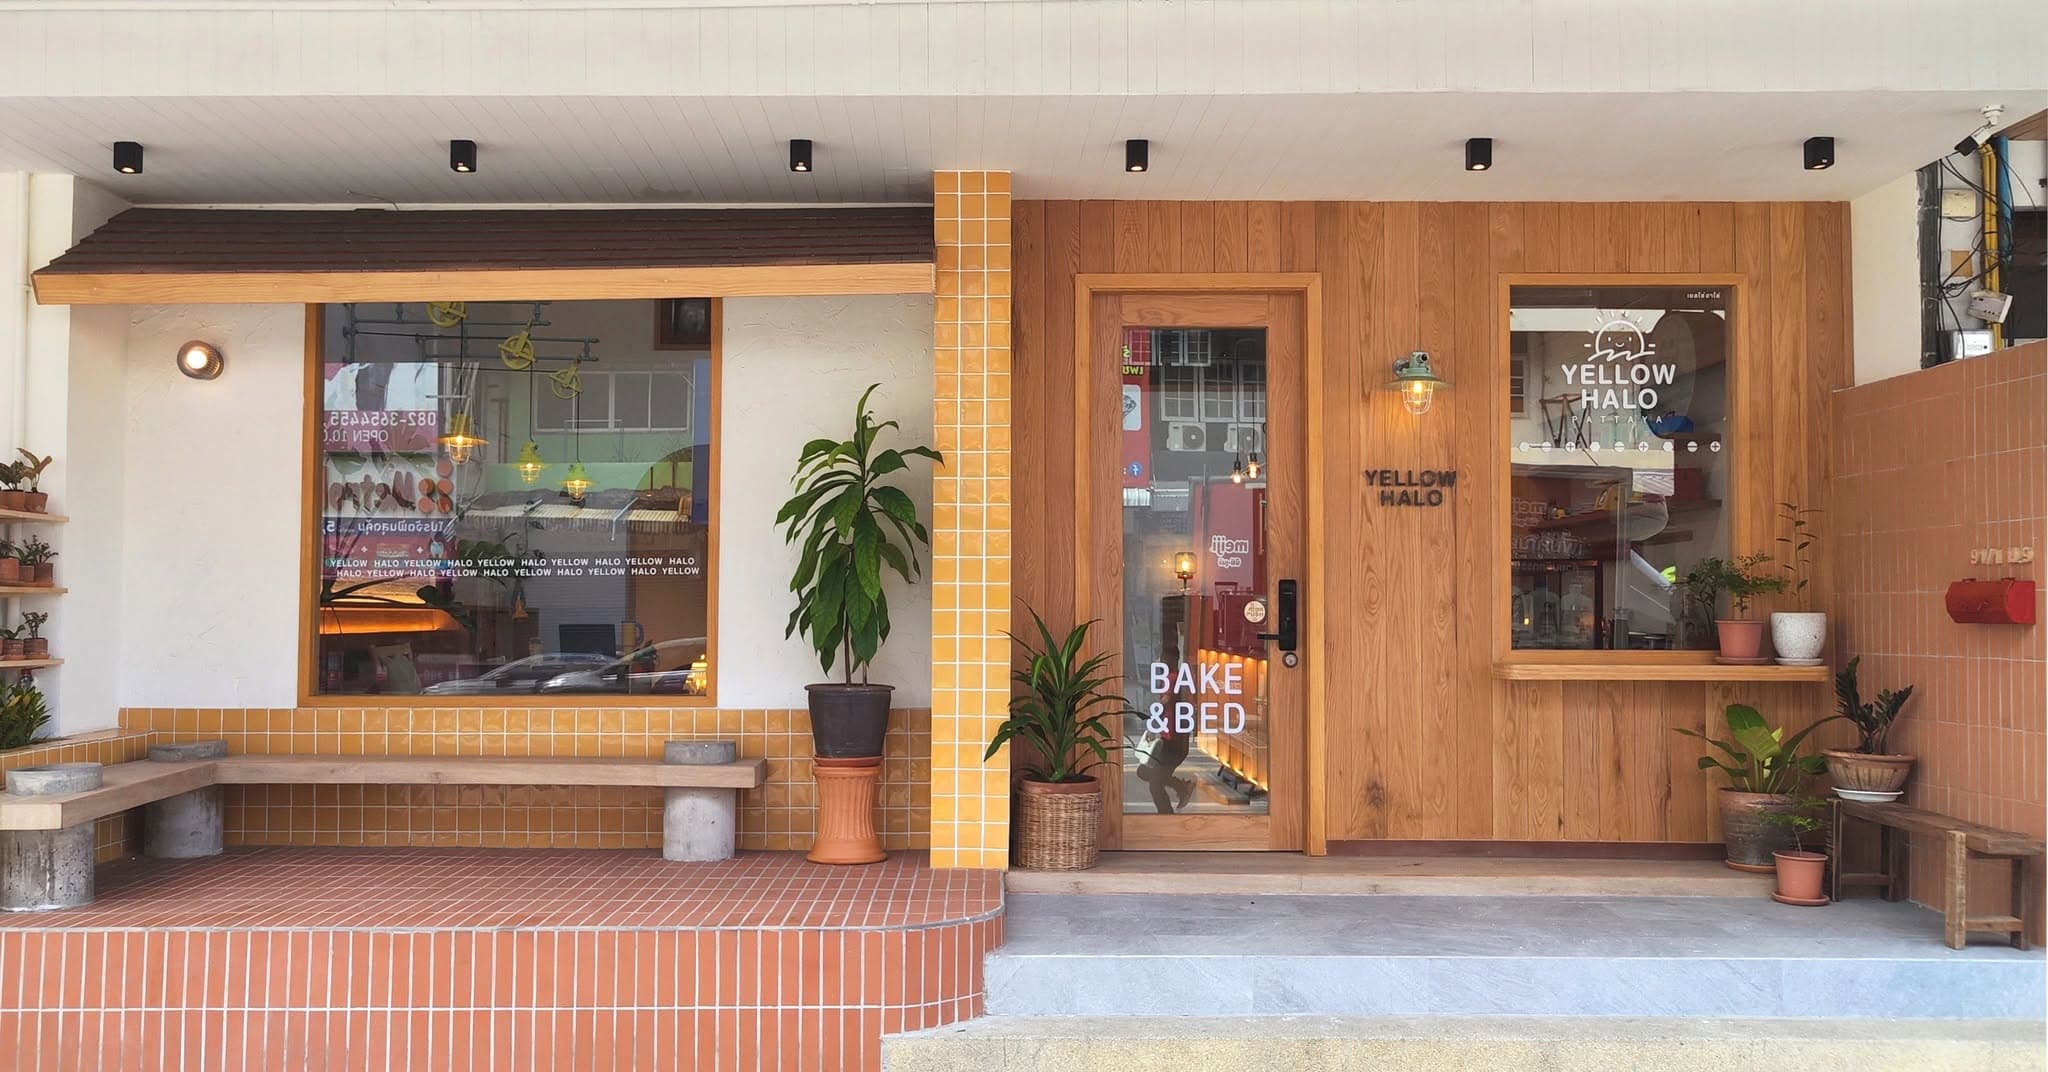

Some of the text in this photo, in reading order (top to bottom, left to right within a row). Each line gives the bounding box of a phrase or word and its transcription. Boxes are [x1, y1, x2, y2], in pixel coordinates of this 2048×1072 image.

[1561, 363, 1676, 385] YELLOW
[1581, 388, 1659, 410] HALO
[1571, 415, 1663, 424] PATTAYA
[1364, 469, 1457, 488] YELLOW
[1380, 489, 1443, 507] HALO
[331, 557, 695, 568] YELLOW HALO YELLOW HALO YELLOW HALO YELLOW HALO YELLOW HALO
[337, 567, 700, 578] HALO YELLOW HALO YELLOW HALO YELLOW HALO YELLOW HALO YELLOW
[1150, 662, 1242, 695] BAKE
[1146, 702, 1245, 735] &BED
